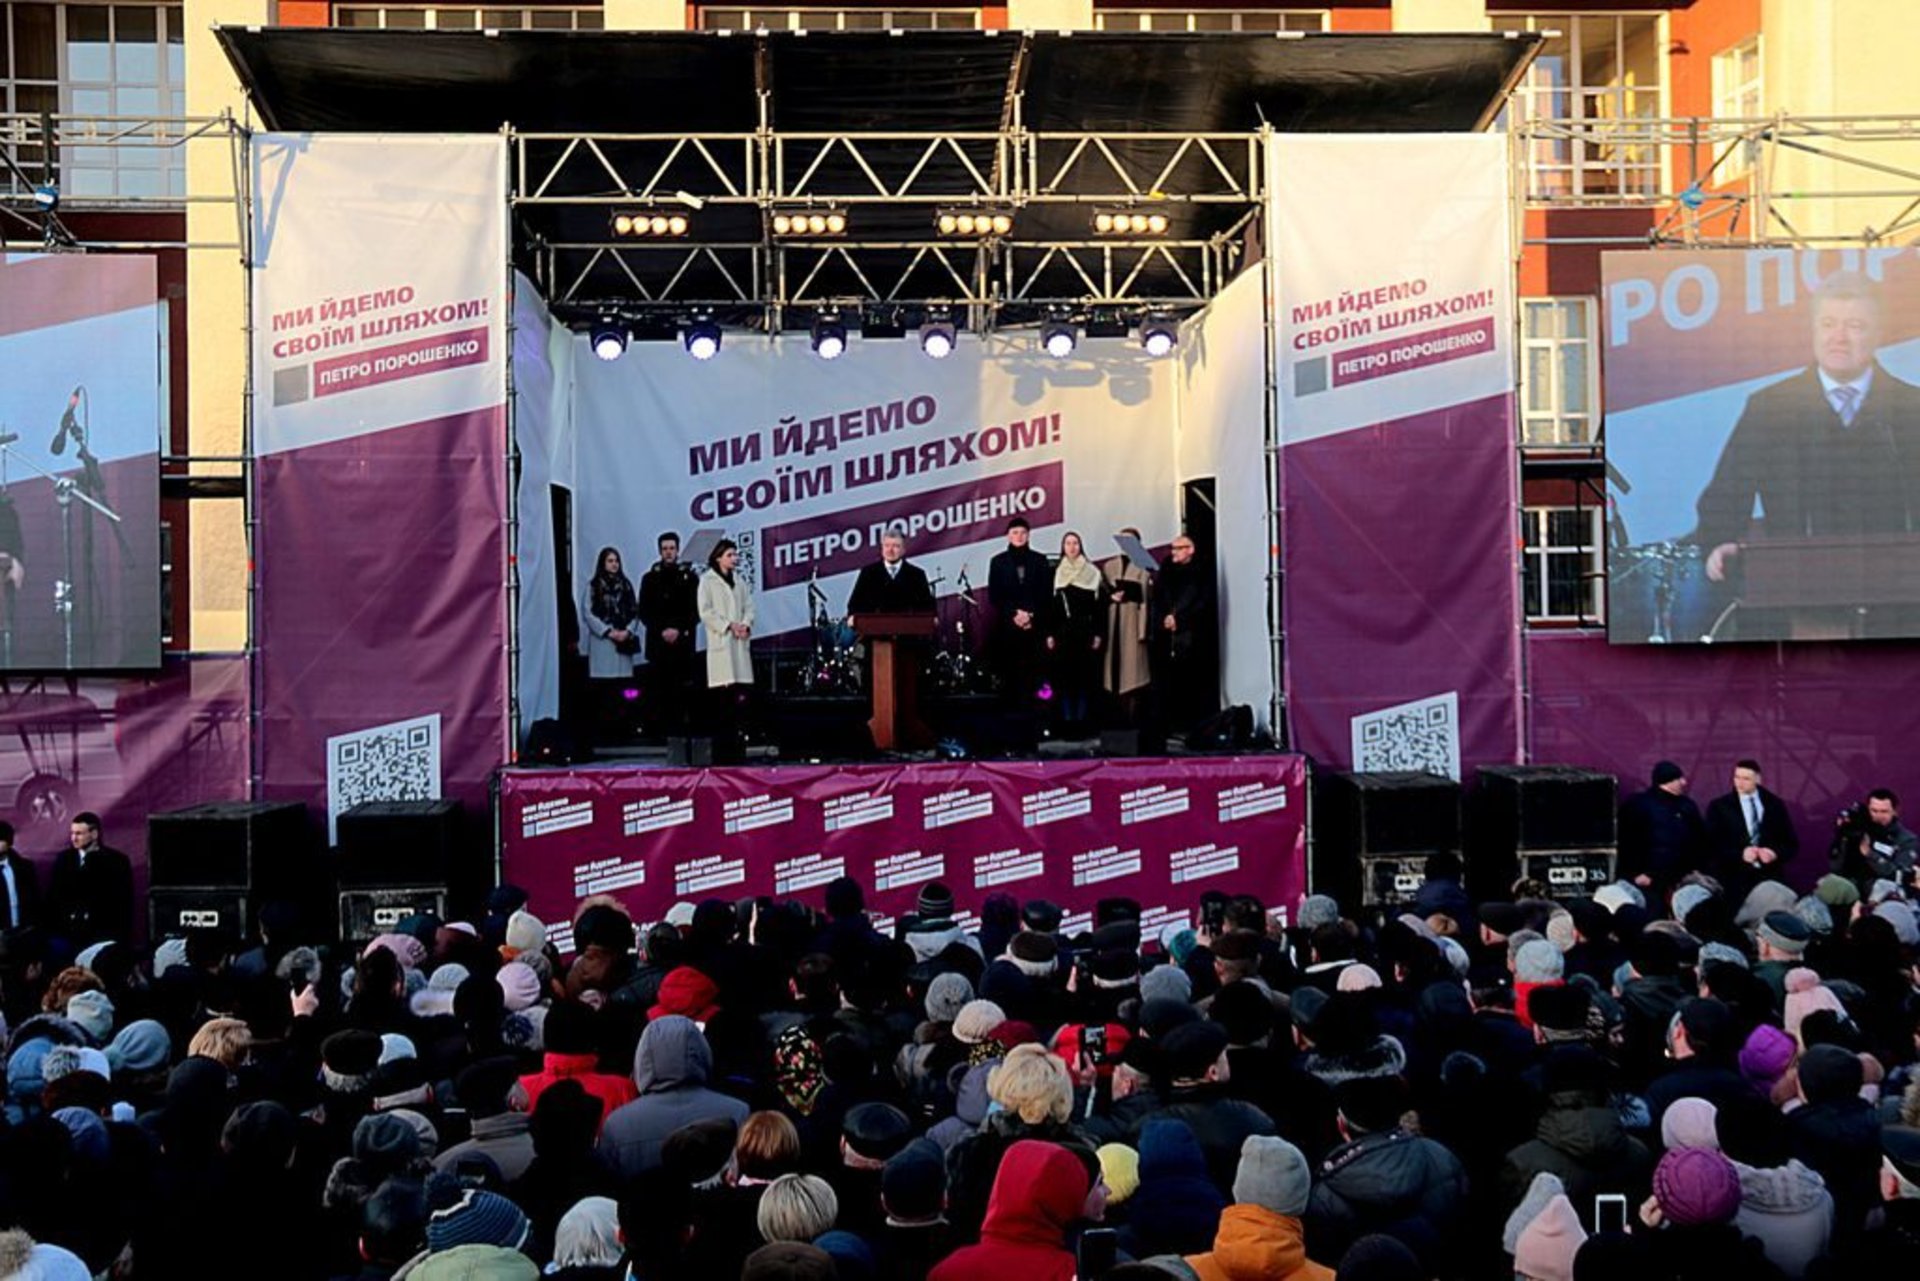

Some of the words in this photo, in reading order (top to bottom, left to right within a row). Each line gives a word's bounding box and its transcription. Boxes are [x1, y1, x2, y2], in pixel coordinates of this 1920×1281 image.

[272, 306, 313, 331] МИ
[320, 286, 415, 320] ЙДЕМО
[1292, 300, 1331, 324] МИ
[1338, 278, 1427, 313] ЙДЕМО
[1293, 317, 1371, 350] СВОЇМ
[1377, 289, 1494, 331] ШЛЯХОМ!
[273, 325, 354, 358] СВОЇМ
[361, 299, 488, 339] ШЛЯХОМ!
[320, 363, 371, 385] ПЕТРО
[374, 340, 479, 373] ПОРОШЕНКО
[1338, 353, 1388, 375] ПЕТРО
[1390, 331, 1485, 362] ПОРОШЕНКО
[689, 432, 761, 476] МИ
[773, 395, 937, 457] ЙДЕМО
[690, 465, 832, 521] СВОЇМ
[845, 413, 1061, 488] ШЛЯХОМ!
[773, 528, 861, 568] ПЕТРО
